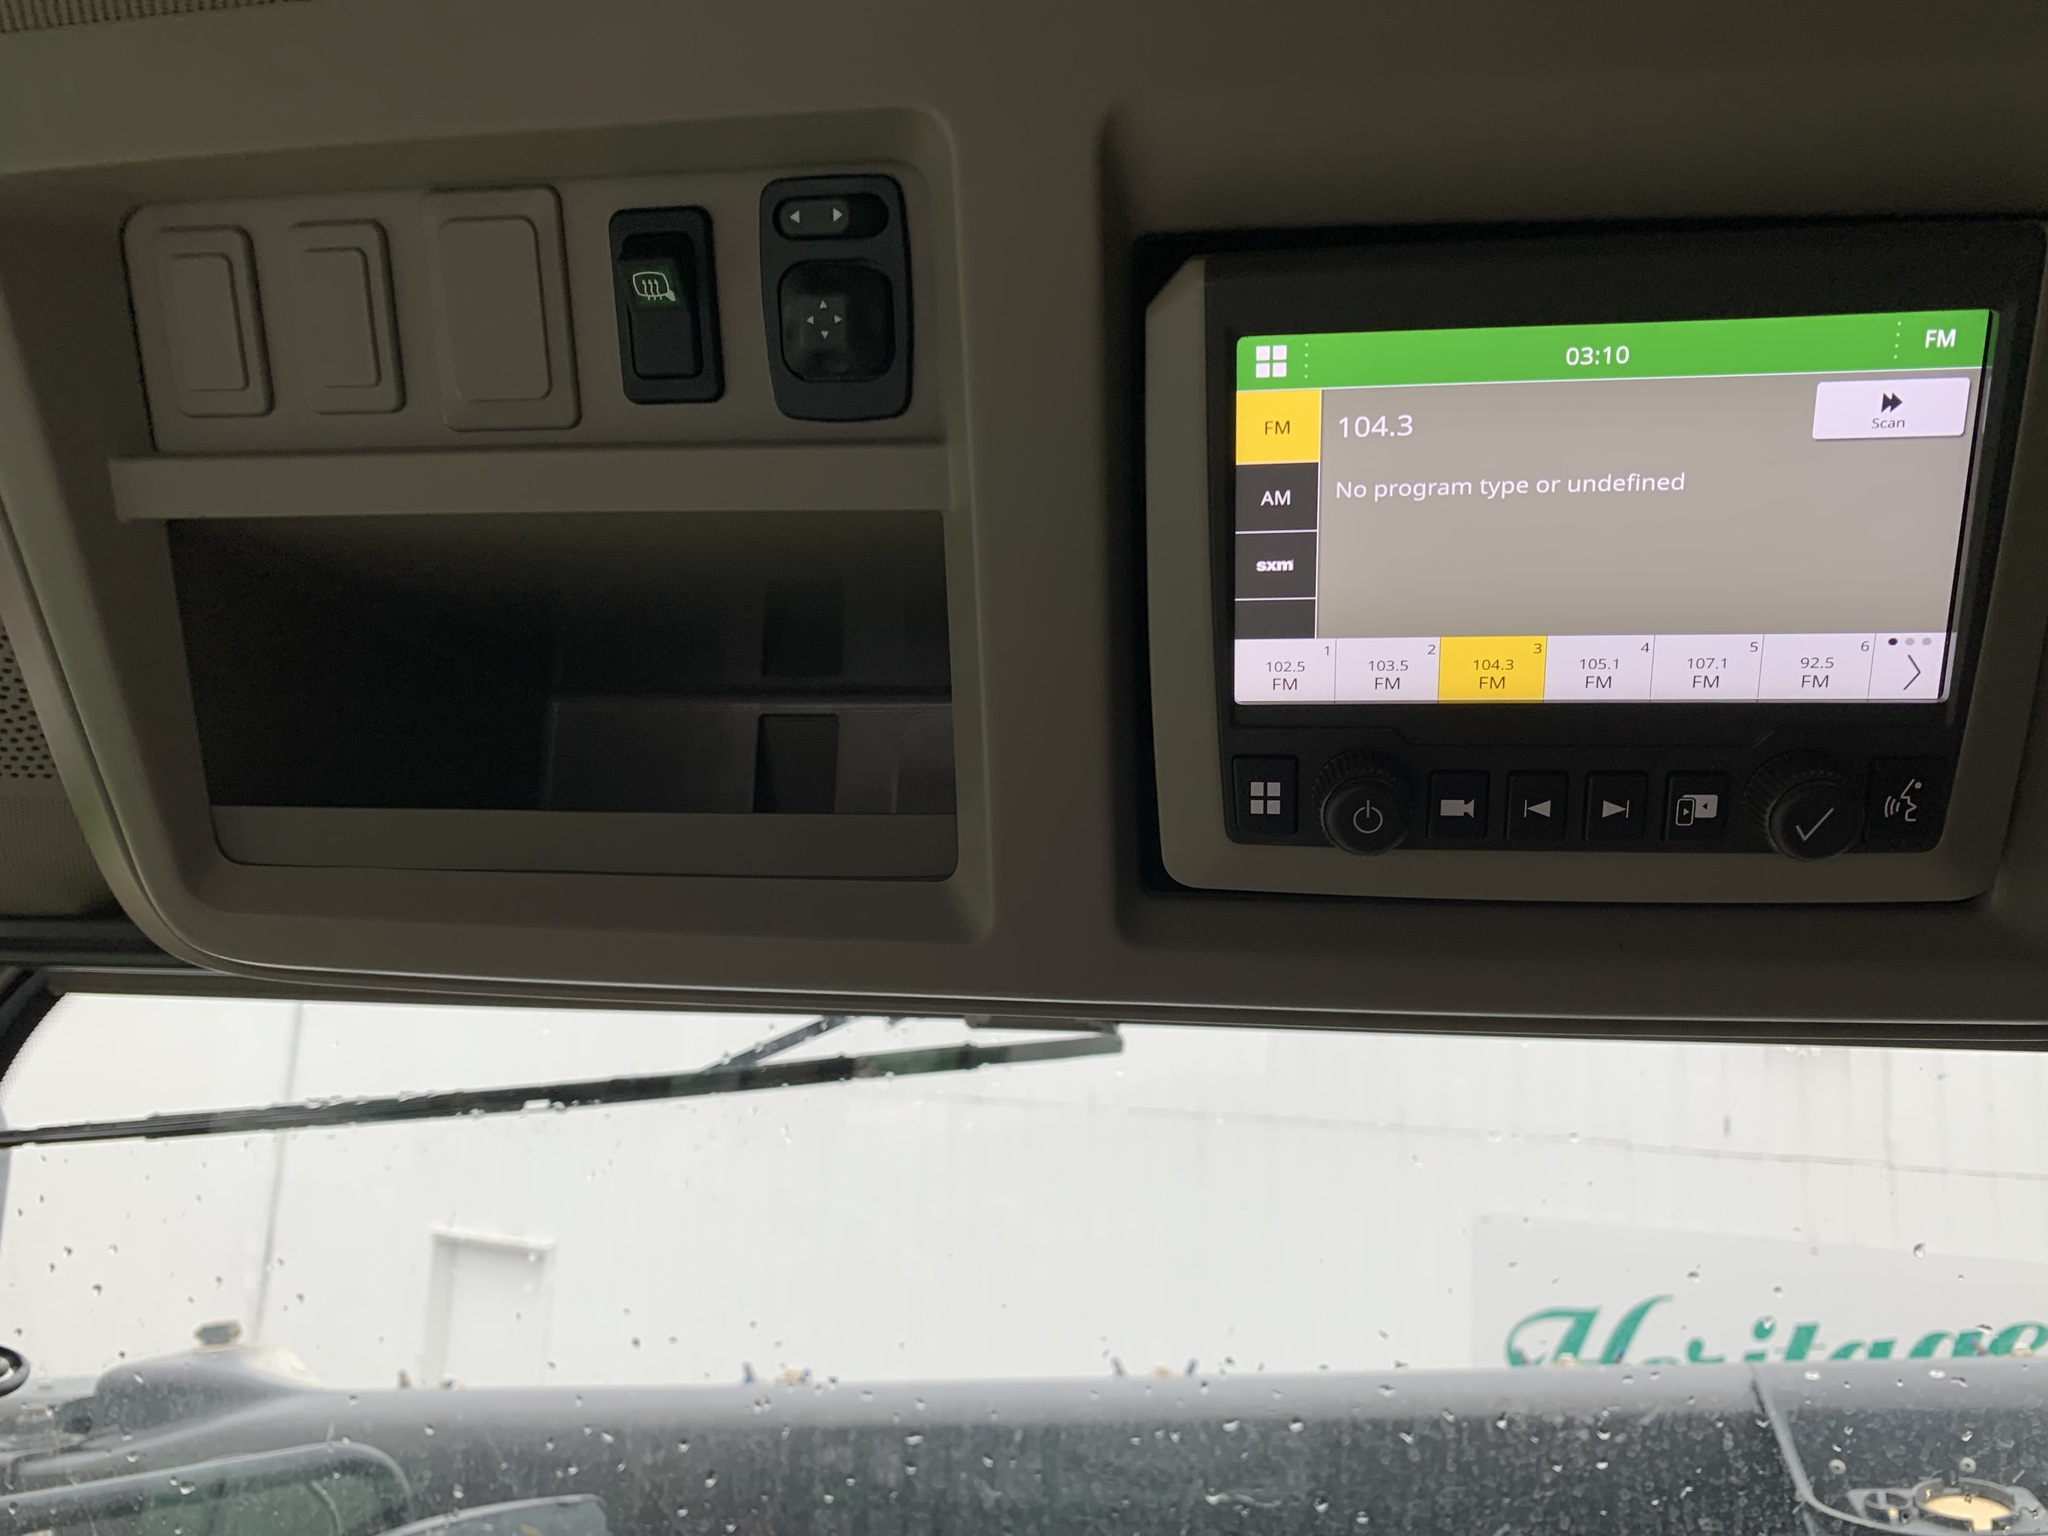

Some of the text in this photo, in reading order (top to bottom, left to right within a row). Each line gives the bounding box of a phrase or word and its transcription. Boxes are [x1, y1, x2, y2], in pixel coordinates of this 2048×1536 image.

[1925, 328, 1957, 349] FM
[1565, 345, 1630, 366] 03:10
[1264, 420, 1291, 435] FM
[1339, 414, 1413, 438] 104.3
[1871, 417, 1906, 429] Scan
[1336, 471, 1685, 503] No program type or undefined
[1260, 489, 1291, 507] AM
[1256, 559, 1294, 572] sxm
[1324, 645, 1330, 656] 1
[1427, 644, 1436, 655] 2
[1533, 643, 1542, 654] 3
[1640, 642, 1649, 653] 4
[1749, 641, 1759, 653] 5
[1860, 640, 1870, 652] 6
[1266, 661, 1306, 673] 102.5
[1368, 659, 1409, 672] 103.5
[1473, 659, 1514, 671] 104.3
[1579, 658, 1619, 670] 105.1
[1687, 657, 1727, 670] 107.1
[1800, 656, 1835, 669] 92.5
[1272, 677, 1298, 691] FM
[1374, 677, 1401, 690] FM
[1479, 676, 1506, 690] FM
[1585, 675, 1612, 689] FM
[1692, 675, 1720, 689] FM
[1801, 674, 1829, 688] FM
